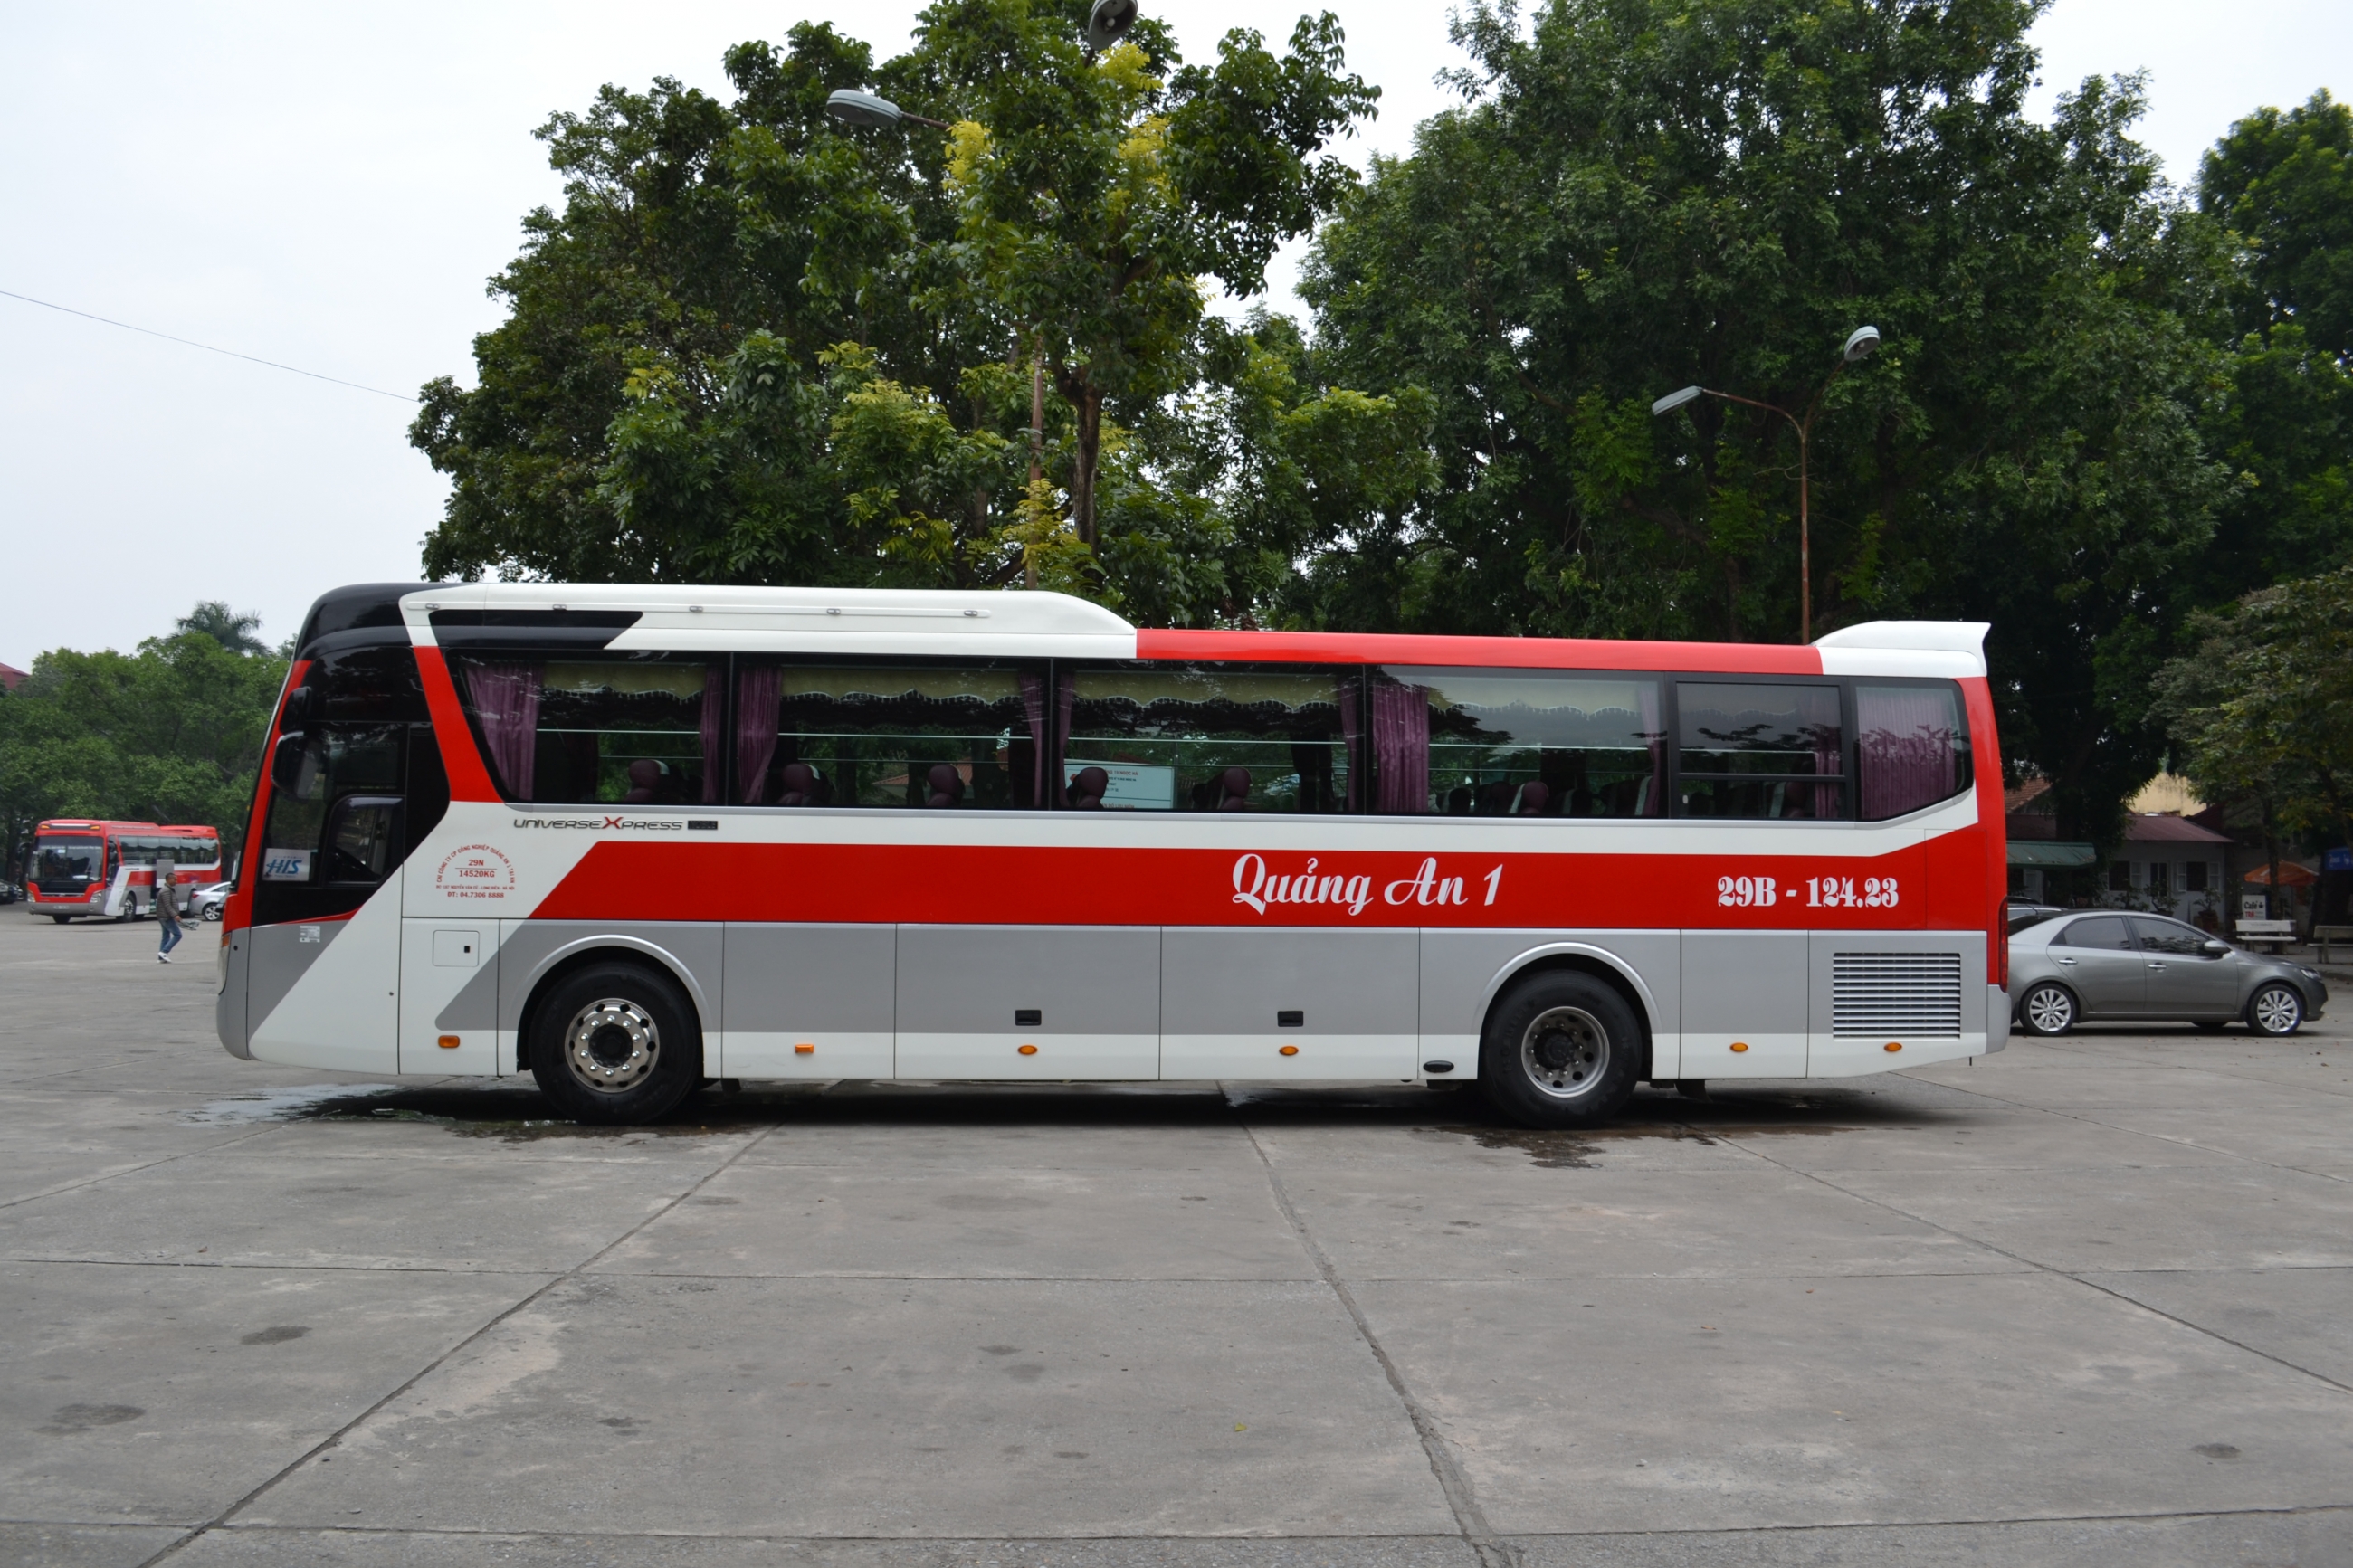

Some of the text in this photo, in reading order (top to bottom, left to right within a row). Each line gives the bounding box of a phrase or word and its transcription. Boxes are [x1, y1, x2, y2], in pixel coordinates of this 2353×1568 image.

[266, 859, 302, 875] HIS
[468, 859, 484, 867] 29N
[1232, 853, 1503, 916] Quảng An 1
[1718, 876, 1777, 907] 29B
[1805, 876, 1899, 908] 124.23
